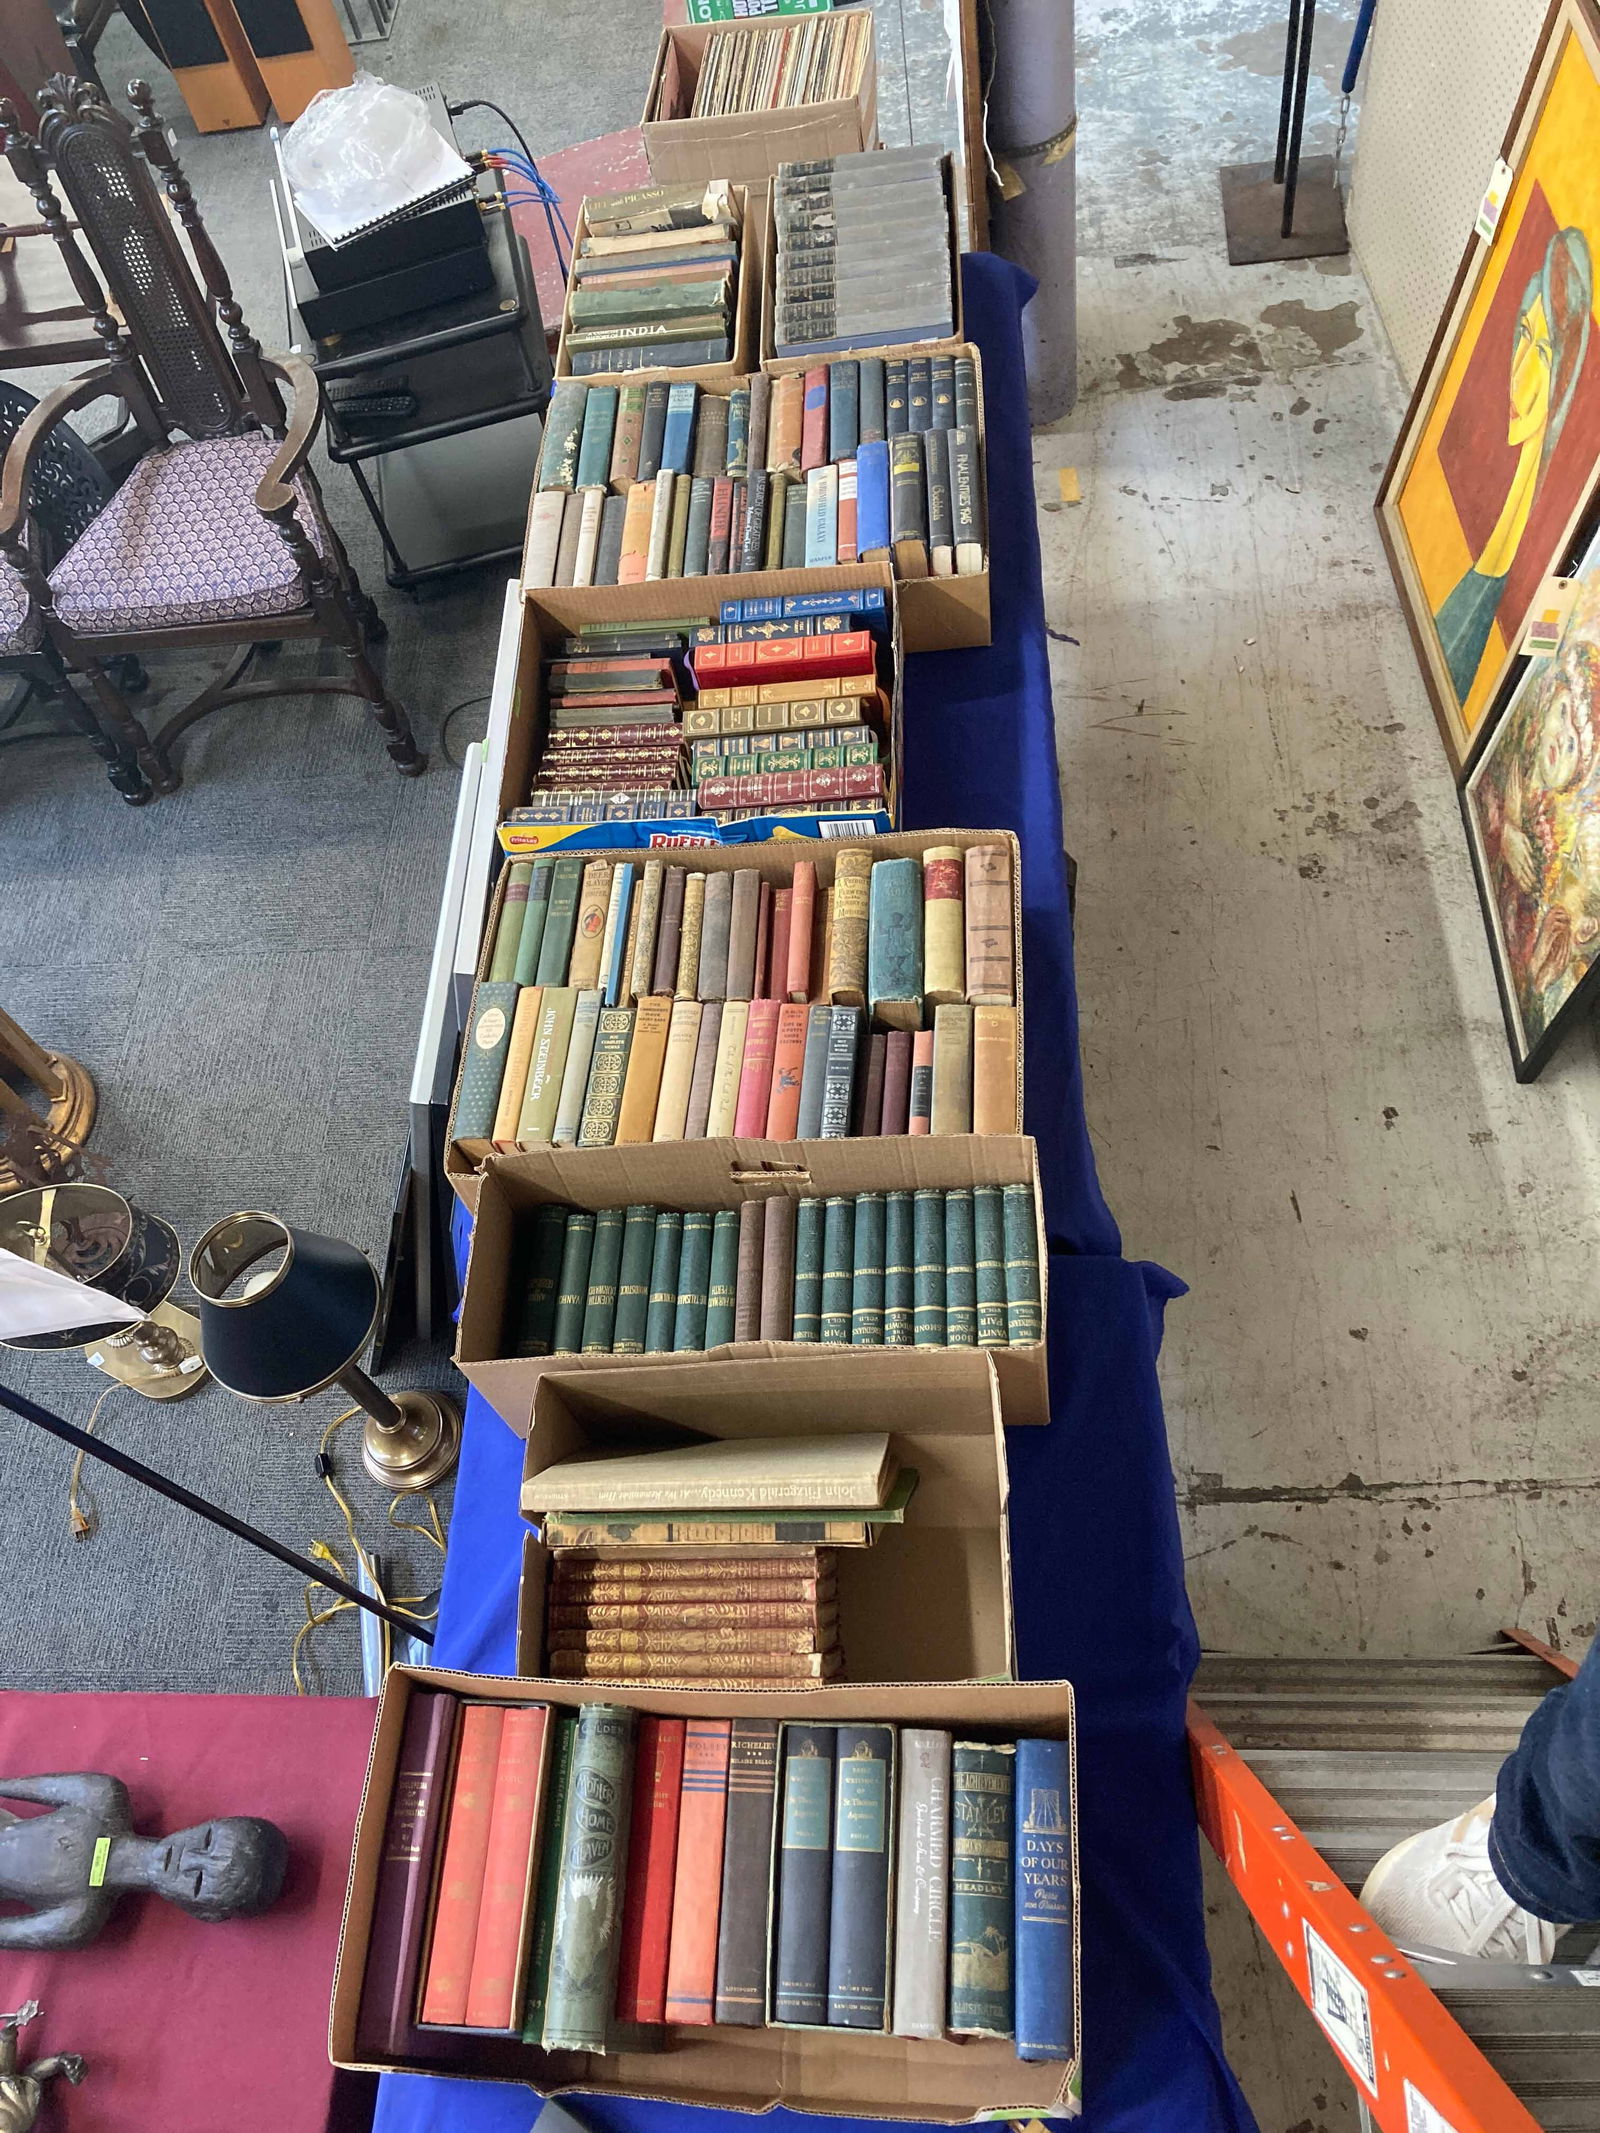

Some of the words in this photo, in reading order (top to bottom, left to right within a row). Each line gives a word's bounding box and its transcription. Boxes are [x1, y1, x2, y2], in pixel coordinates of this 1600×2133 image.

[624, 189, 664, 204] PICASSO
[619, 324, 667, 337] INDIA
[543, 1008, 557, 1035] JOHN
[980, 1317, 1003, 1326] FAIR
[823, 1328, 847, 1337] FAIR
[949, 1334, 974, 1343] BOOK
[978, 1328, 1007, 1338] VANITY
[758, 1485, 822, 1502] Fitzgerald
[824, 1484, 856, 1498] John
[581, 1722, 625, 1735] GLDEN
[731, 1741, 777, 1750] RICHELIEU
[559, 1754, 568, 1776] YOUR
[577, 1774, 615, 1802] MOTHER
[554, 1777, 565, 1828] HEIRLOOMS
[580, 1808, 613, 1834] HOME
[930, 1777, 946, 1869] CHARMED
[1026, 1839, 1064, 1853] DAYS
[1021, 1856, 1038, 1868] OF
[1041, 1858, 1070, 1871] OUR
[1024, 1872, 1068, 1887] YEARS
[955, 1882, 1003, 1894] HEADLEY
[928, 1876, 943, 1943] CIRCLE
